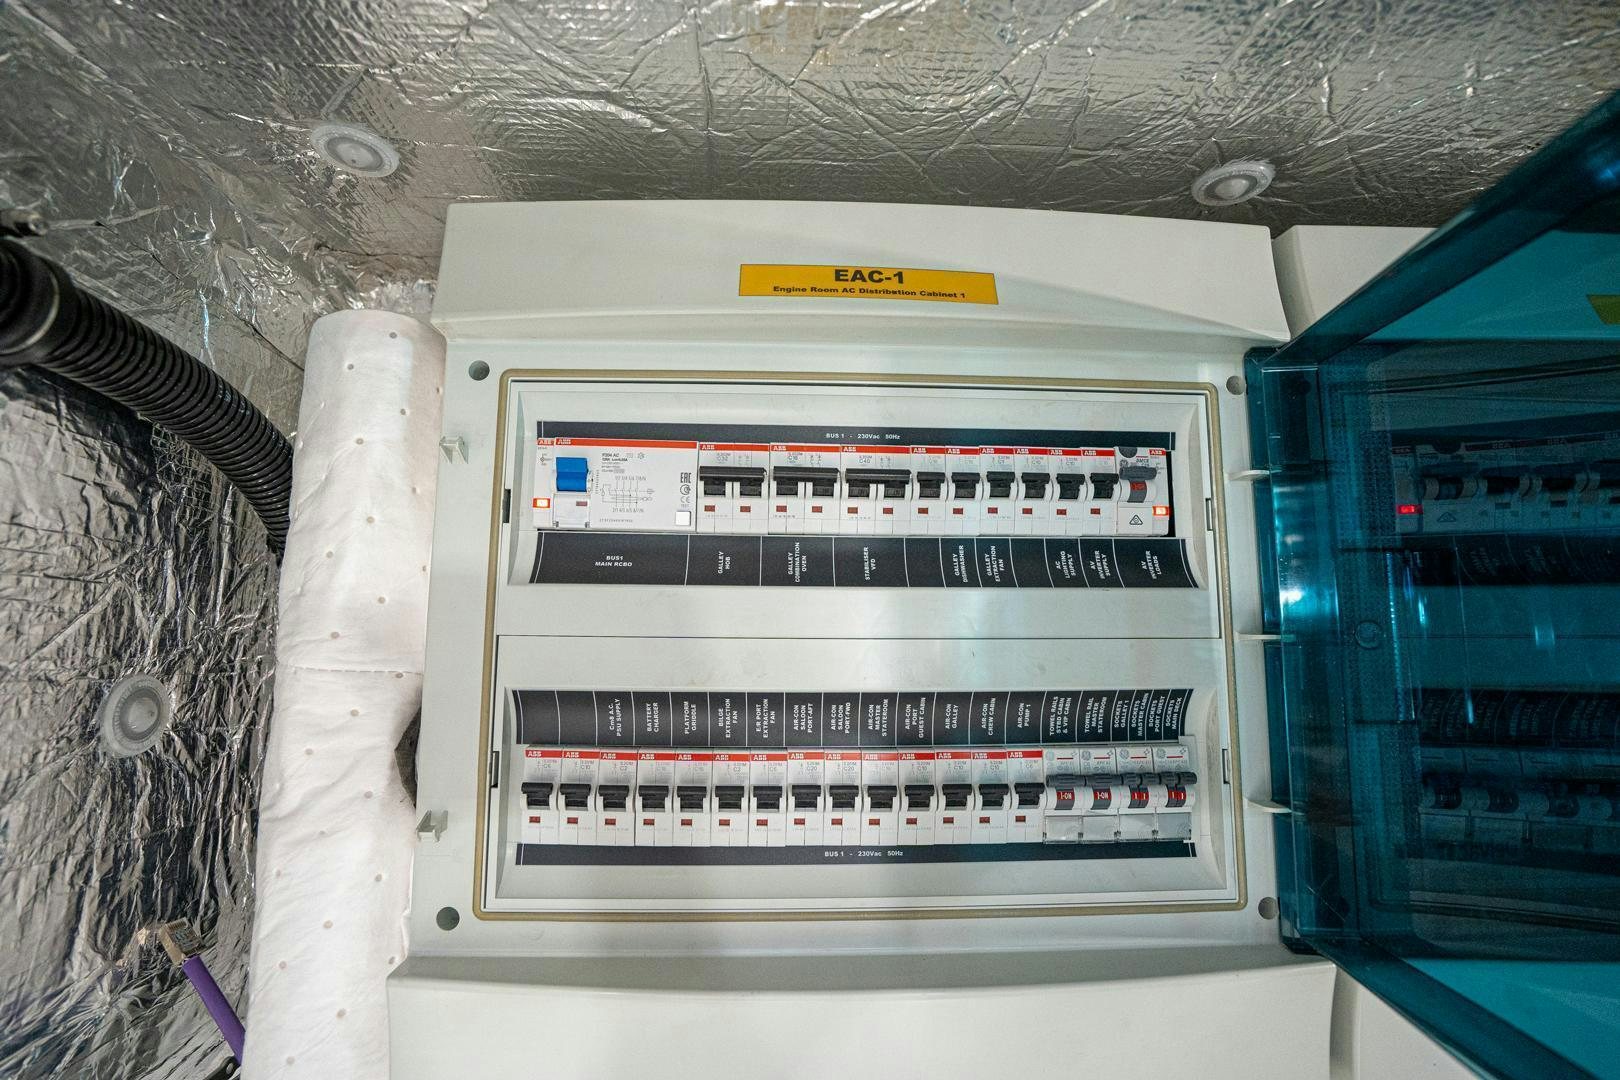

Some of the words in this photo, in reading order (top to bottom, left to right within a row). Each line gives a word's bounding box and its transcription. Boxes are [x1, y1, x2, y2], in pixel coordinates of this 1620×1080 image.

[834, 268, 904, 284] EAC-1
[773, 286, 806, 294] Engine
[858, 288, 916, 296] Distribution
[920, 290, 958, 298] Cabinet
[959, 545, 968, 582] DISHWASHER
[990, 545, 1000, 582] EXTRACTION
[1055, 561, 1061, 569] AC
[1060, 551, 1070, 578] LIGHTING
[1067, 554, 1076, 576] SUPPLY
[1090, 561, 1096, 569] AV
[1094, 550, 1105, 579] INVERTER
[1101, 554, 1111, 576] SUPPLY
[1141, 561, 1148, 569] AV
[1145, 550, 1157, 579] INVERTER
[1153, 555, 1162, 575] LOADS
[1098, 697, 1107, 733] STATEROOM
[1114, 701, 1122, 728] SOCKETS
[1131, 700, 1140, 727] SOCKETS
[1149, 700, 1158, 727] SOCKETS
[1166, 700, 1175, 726] SOCKETS
